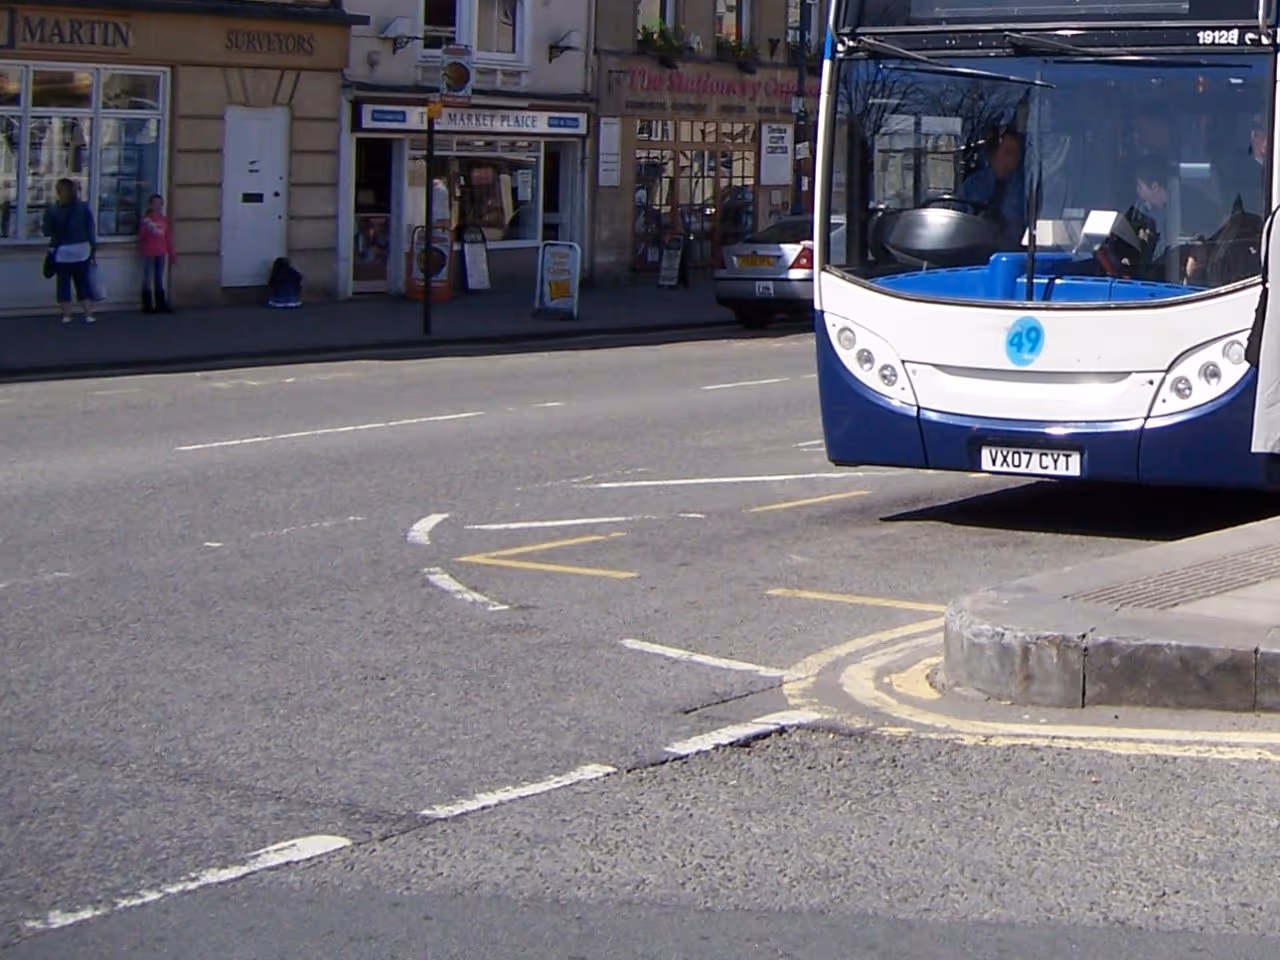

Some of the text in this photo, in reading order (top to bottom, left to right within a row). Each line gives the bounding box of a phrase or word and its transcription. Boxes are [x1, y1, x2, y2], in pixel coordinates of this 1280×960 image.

[21, 16, 132, 48] MARTIN
[225, 29, 315, 54] SURVEYORS
[447, 112, 497, 128] MARKET
[1009, 326, 1042, 354] 49
[989, 449, 1073, 472] VX07 CYT
